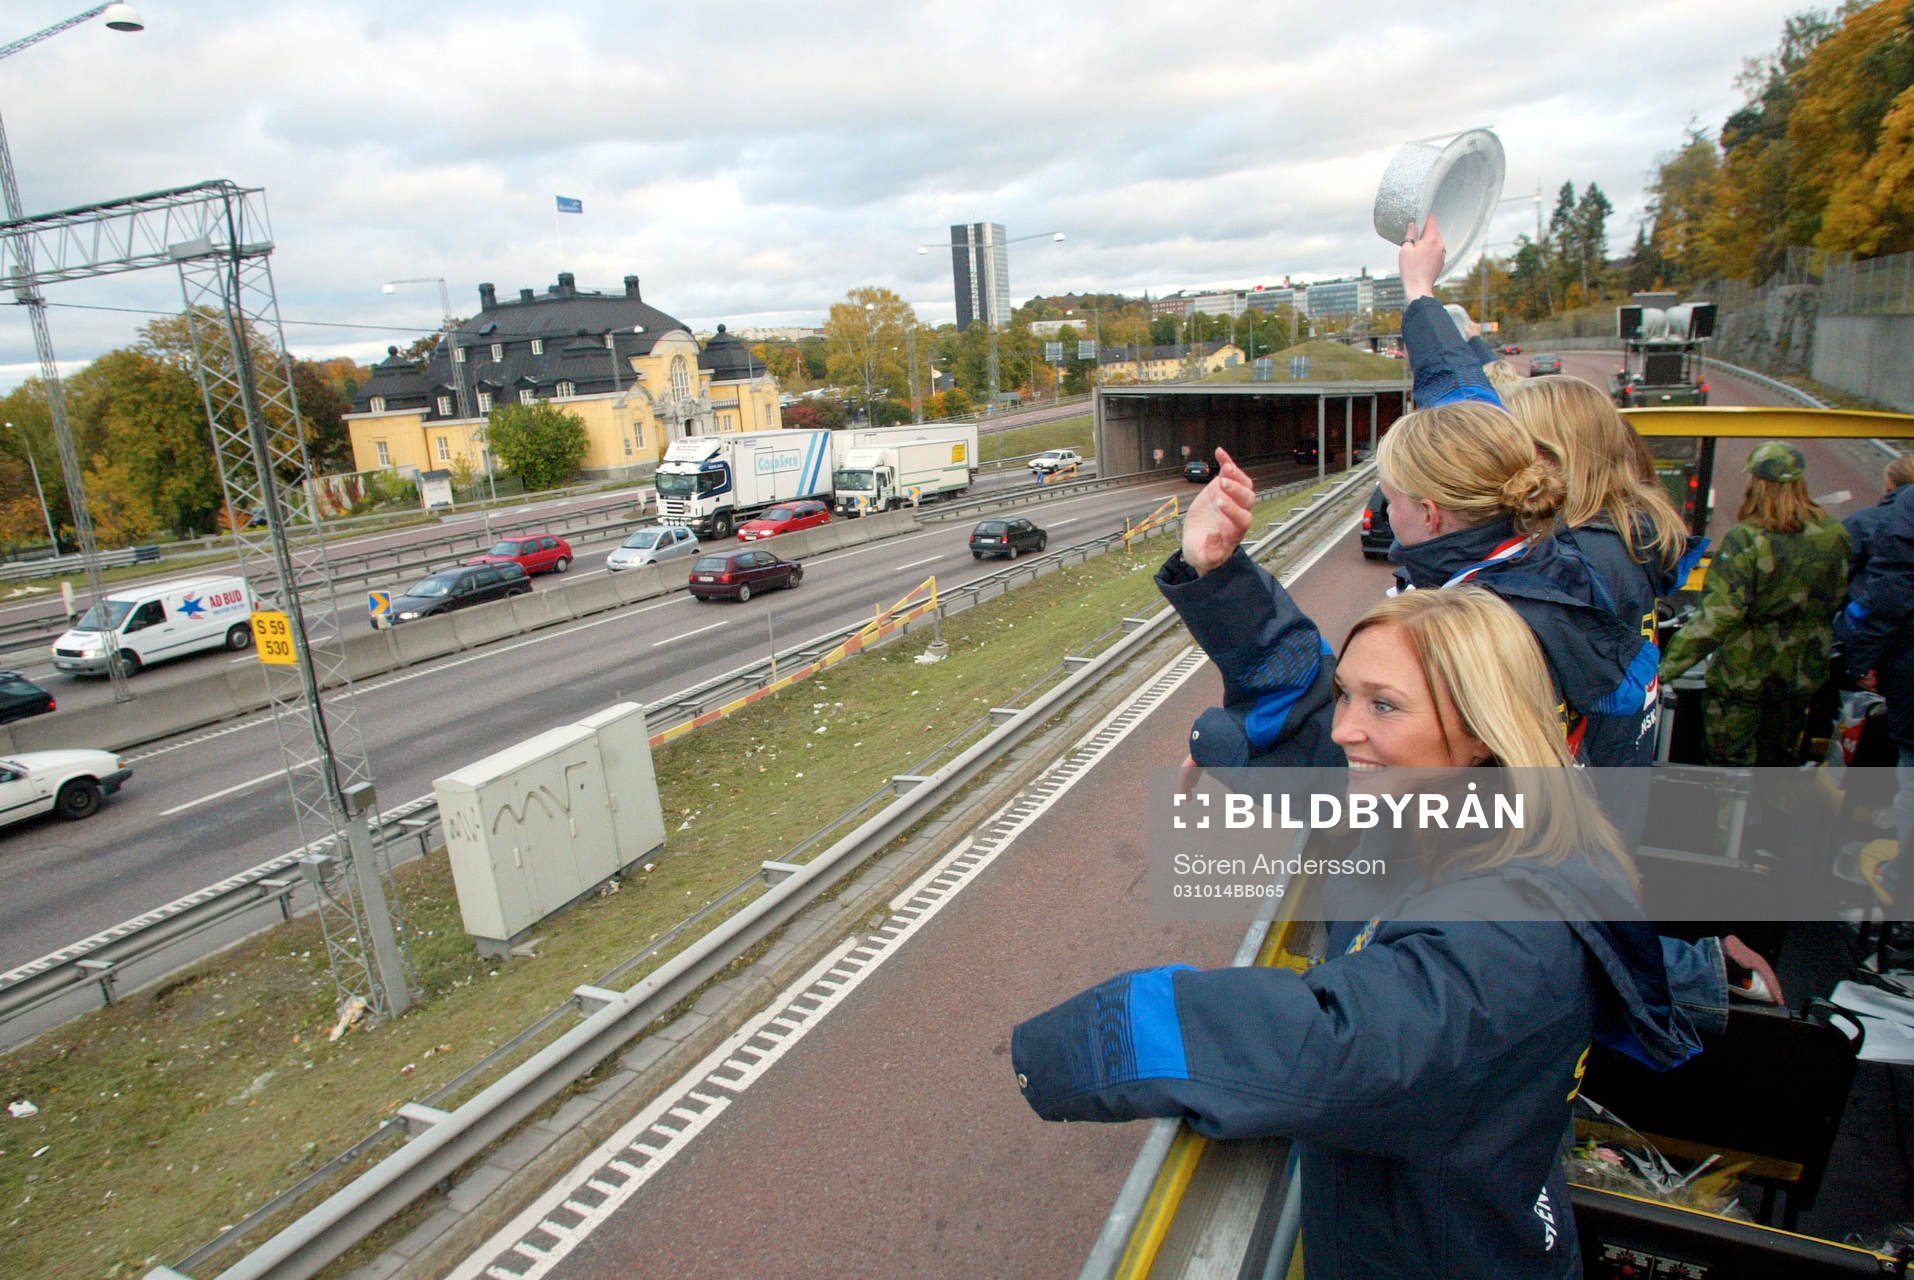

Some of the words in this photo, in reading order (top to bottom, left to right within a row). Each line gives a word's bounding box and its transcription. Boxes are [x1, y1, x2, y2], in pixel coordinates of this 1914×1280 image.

[223, 590, 242, 605] BUD
[256, 619, 267, 634] S
[270, 620, 286, 635] 59
[265, 640, 289, 655] 530
